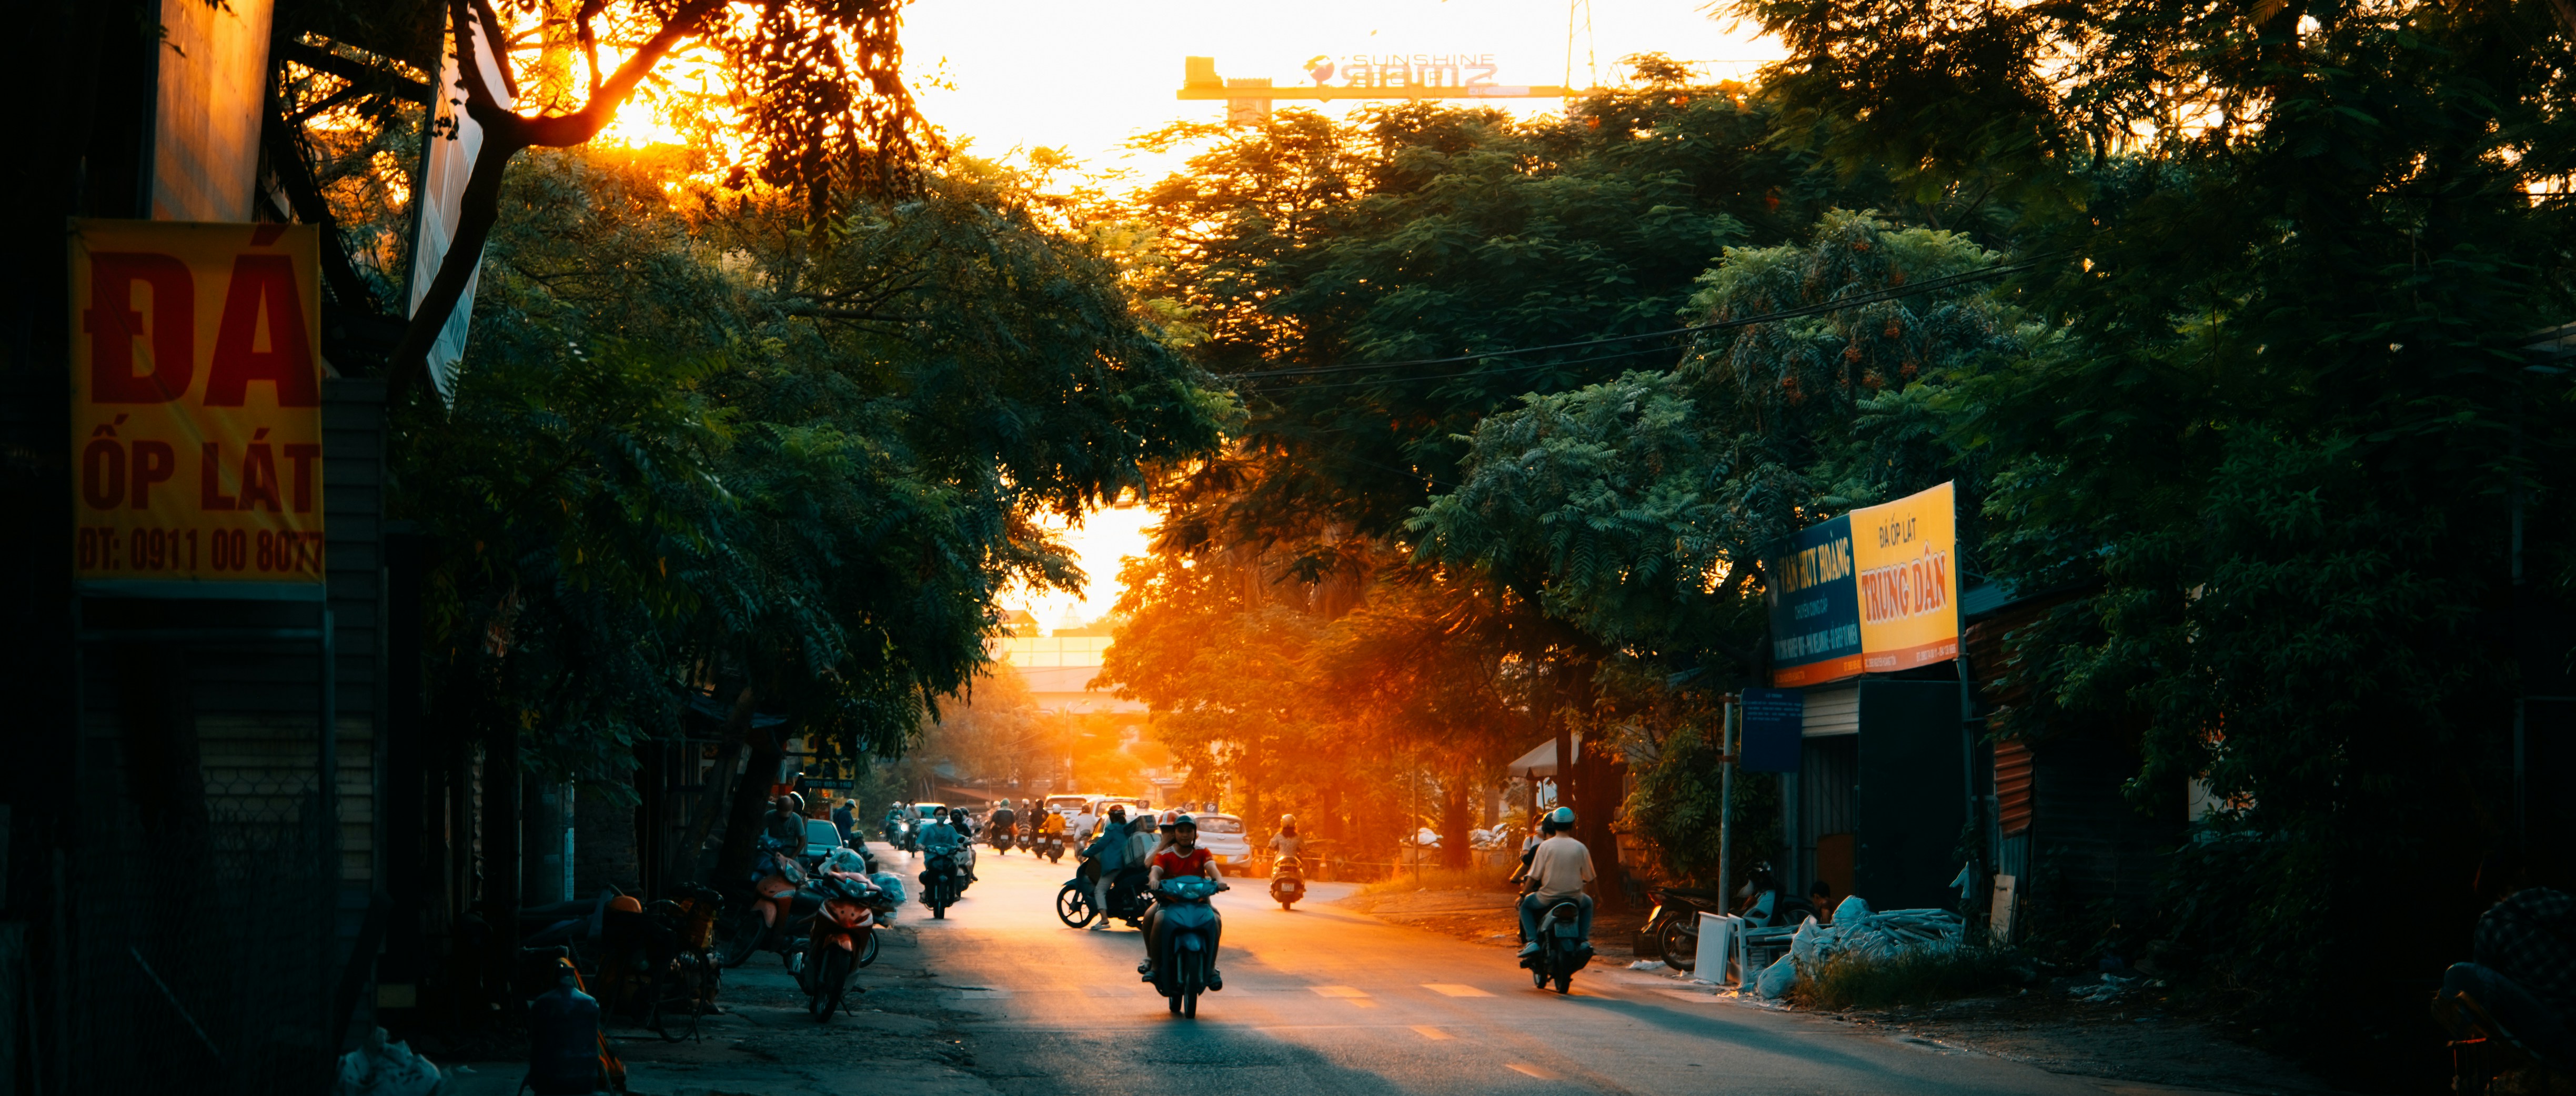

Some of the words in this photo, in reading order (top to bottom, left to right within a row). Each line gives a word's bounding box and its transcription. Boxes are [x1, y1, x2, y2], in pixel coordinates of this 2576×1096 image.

[1353, 54, 1495, 66] SUNSHINE
[83, 224, 320, 408] ĐÁ
[83, 414, 175, 510] ỐP
[200, 427, 321, 513] LÁT
[78, 527, 120, 570] ĐT:
[130, 527, 198, 571] 0911
[212, 530, 247, 572] 00
[256, 530, 324, 574] 8077
[1798, 547, 1818, 590] HUY
[1817, 529, 1850, 584] HOÀNG
[1879, 518, 1889, 549] ĐÁ
[1890, 512, 1900, 546] ỐP
[1903, 512, 1916, 543] LÁT
[1861, 563, 1910, 625] TRUNG
[1911, 540, 1947, 617] DÂN
